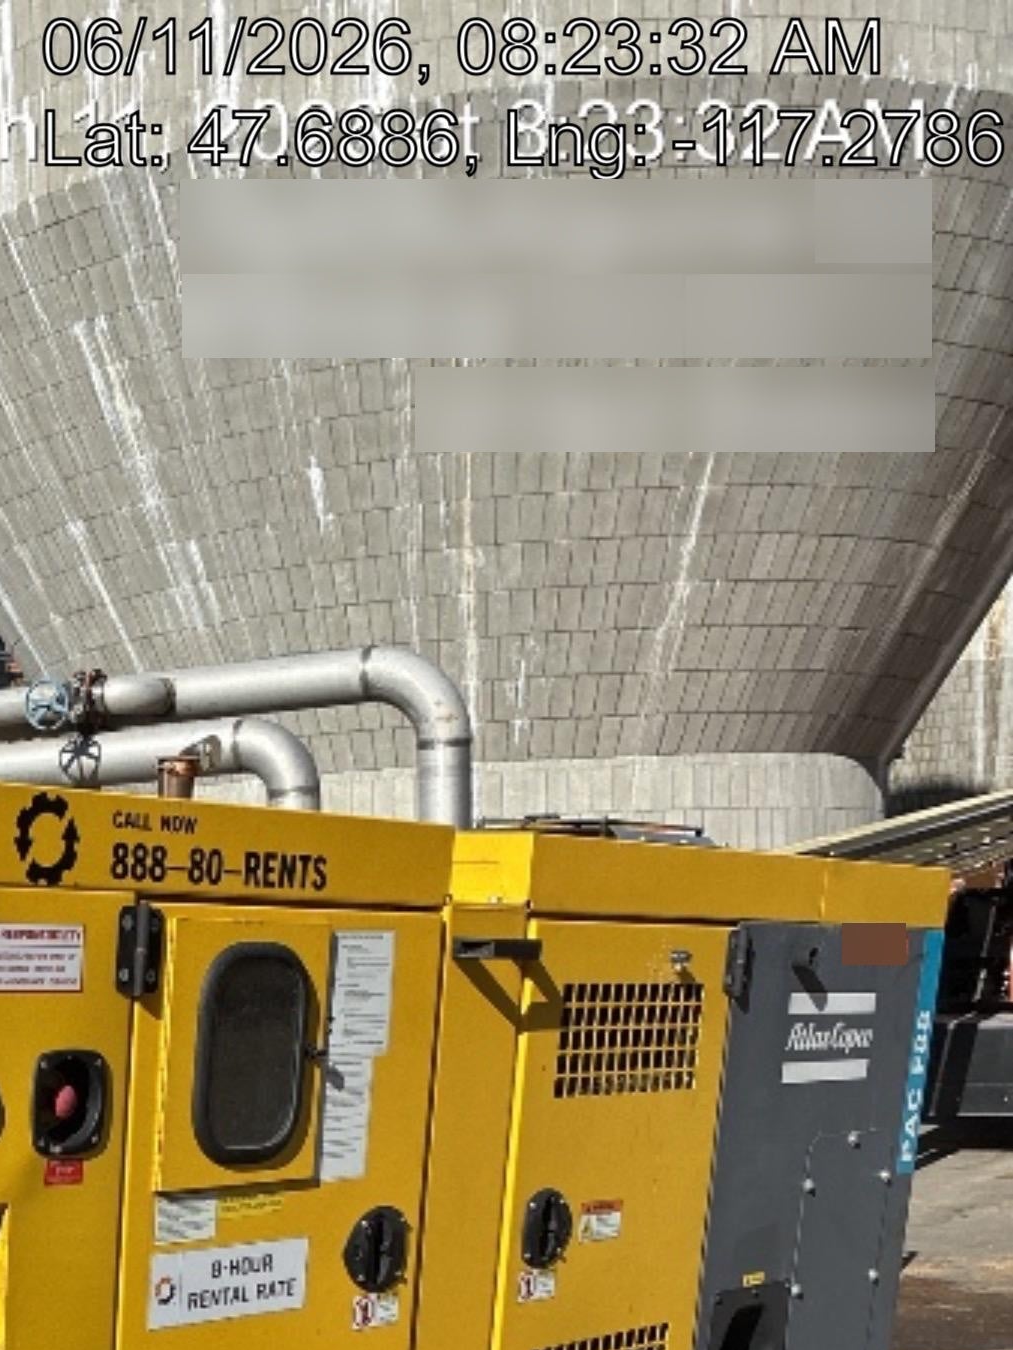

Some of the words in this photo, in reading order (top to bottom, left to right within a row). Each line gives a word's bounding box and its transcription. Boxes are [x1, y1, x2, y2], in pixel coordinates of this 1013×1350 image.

[112, 811, 152, 831] CALL
[160, 815, 198, 834] NOW
[111, 842, 327, 891] 888-80-RENTS
[211, 1254, 274, 1279] 8-HOUR
[187, 1286, 250, 1311] RENTAL
[256, 1278, 297, 1300] RATE
